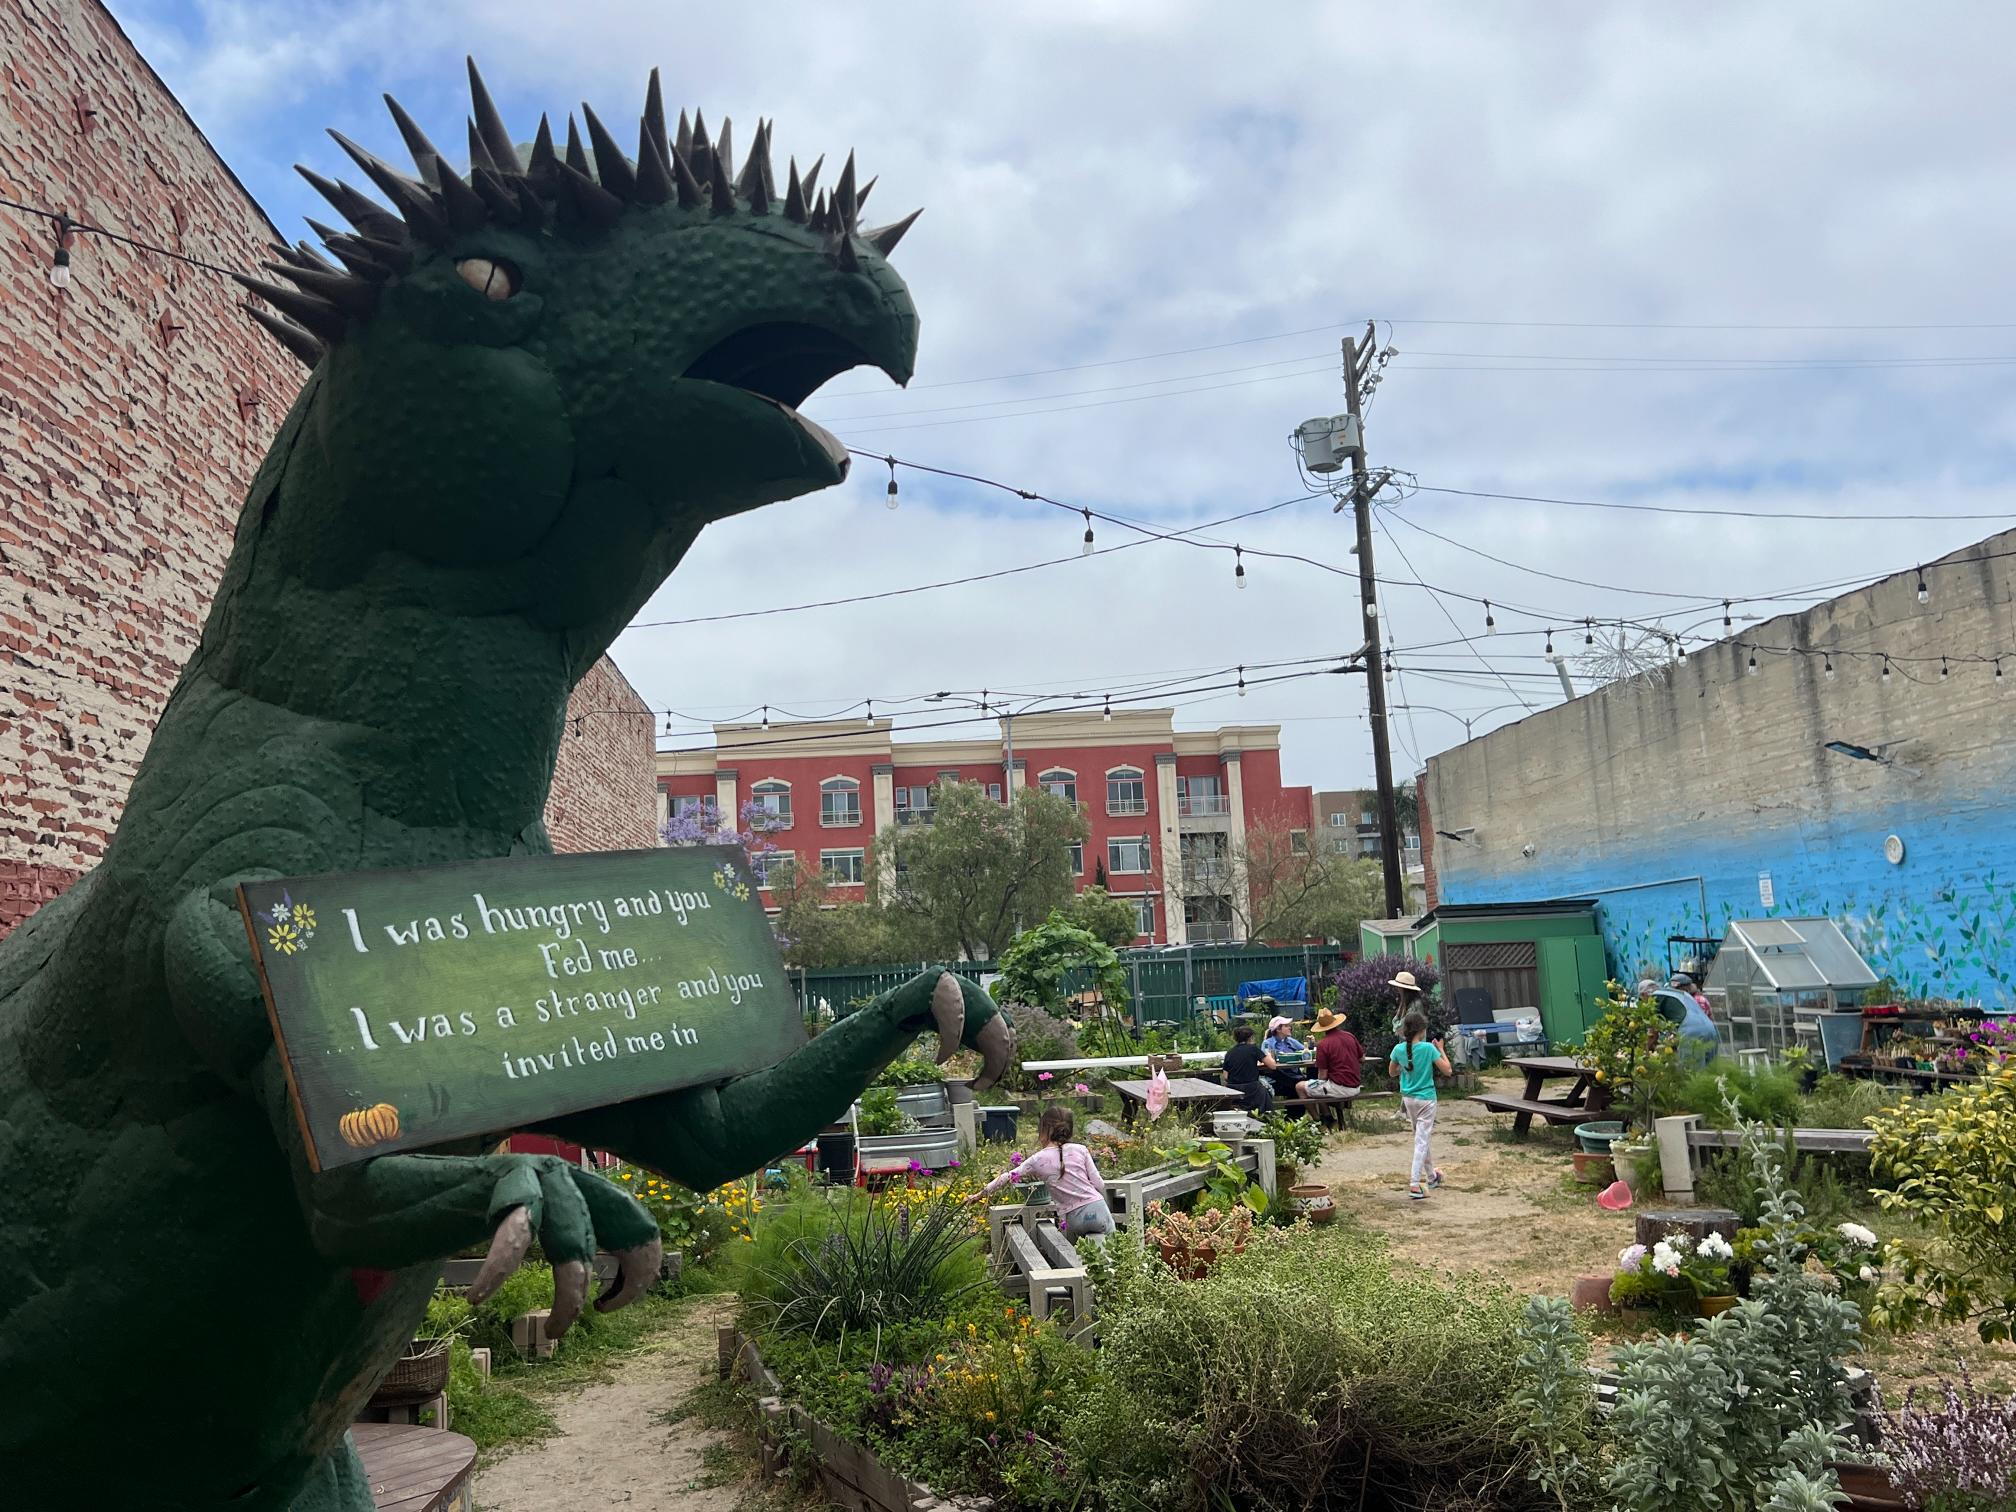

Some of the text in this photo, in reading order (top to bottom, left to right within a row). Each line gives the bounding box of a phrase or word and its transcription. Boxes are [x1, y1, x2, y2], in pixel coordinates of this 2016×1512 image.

[341, 889, 712, 953] I was hungry and you
[537, 938, 593, 979] Fed
[388, 1011, 477, 1044] was
[497, 1006, 519, 1029] a
[536, 984, 662, 1023] stranger
[677, 966, 721, 999] and
[722, 973, 764, 1005] you
[502, 1022, 699, 1079] invited me in
